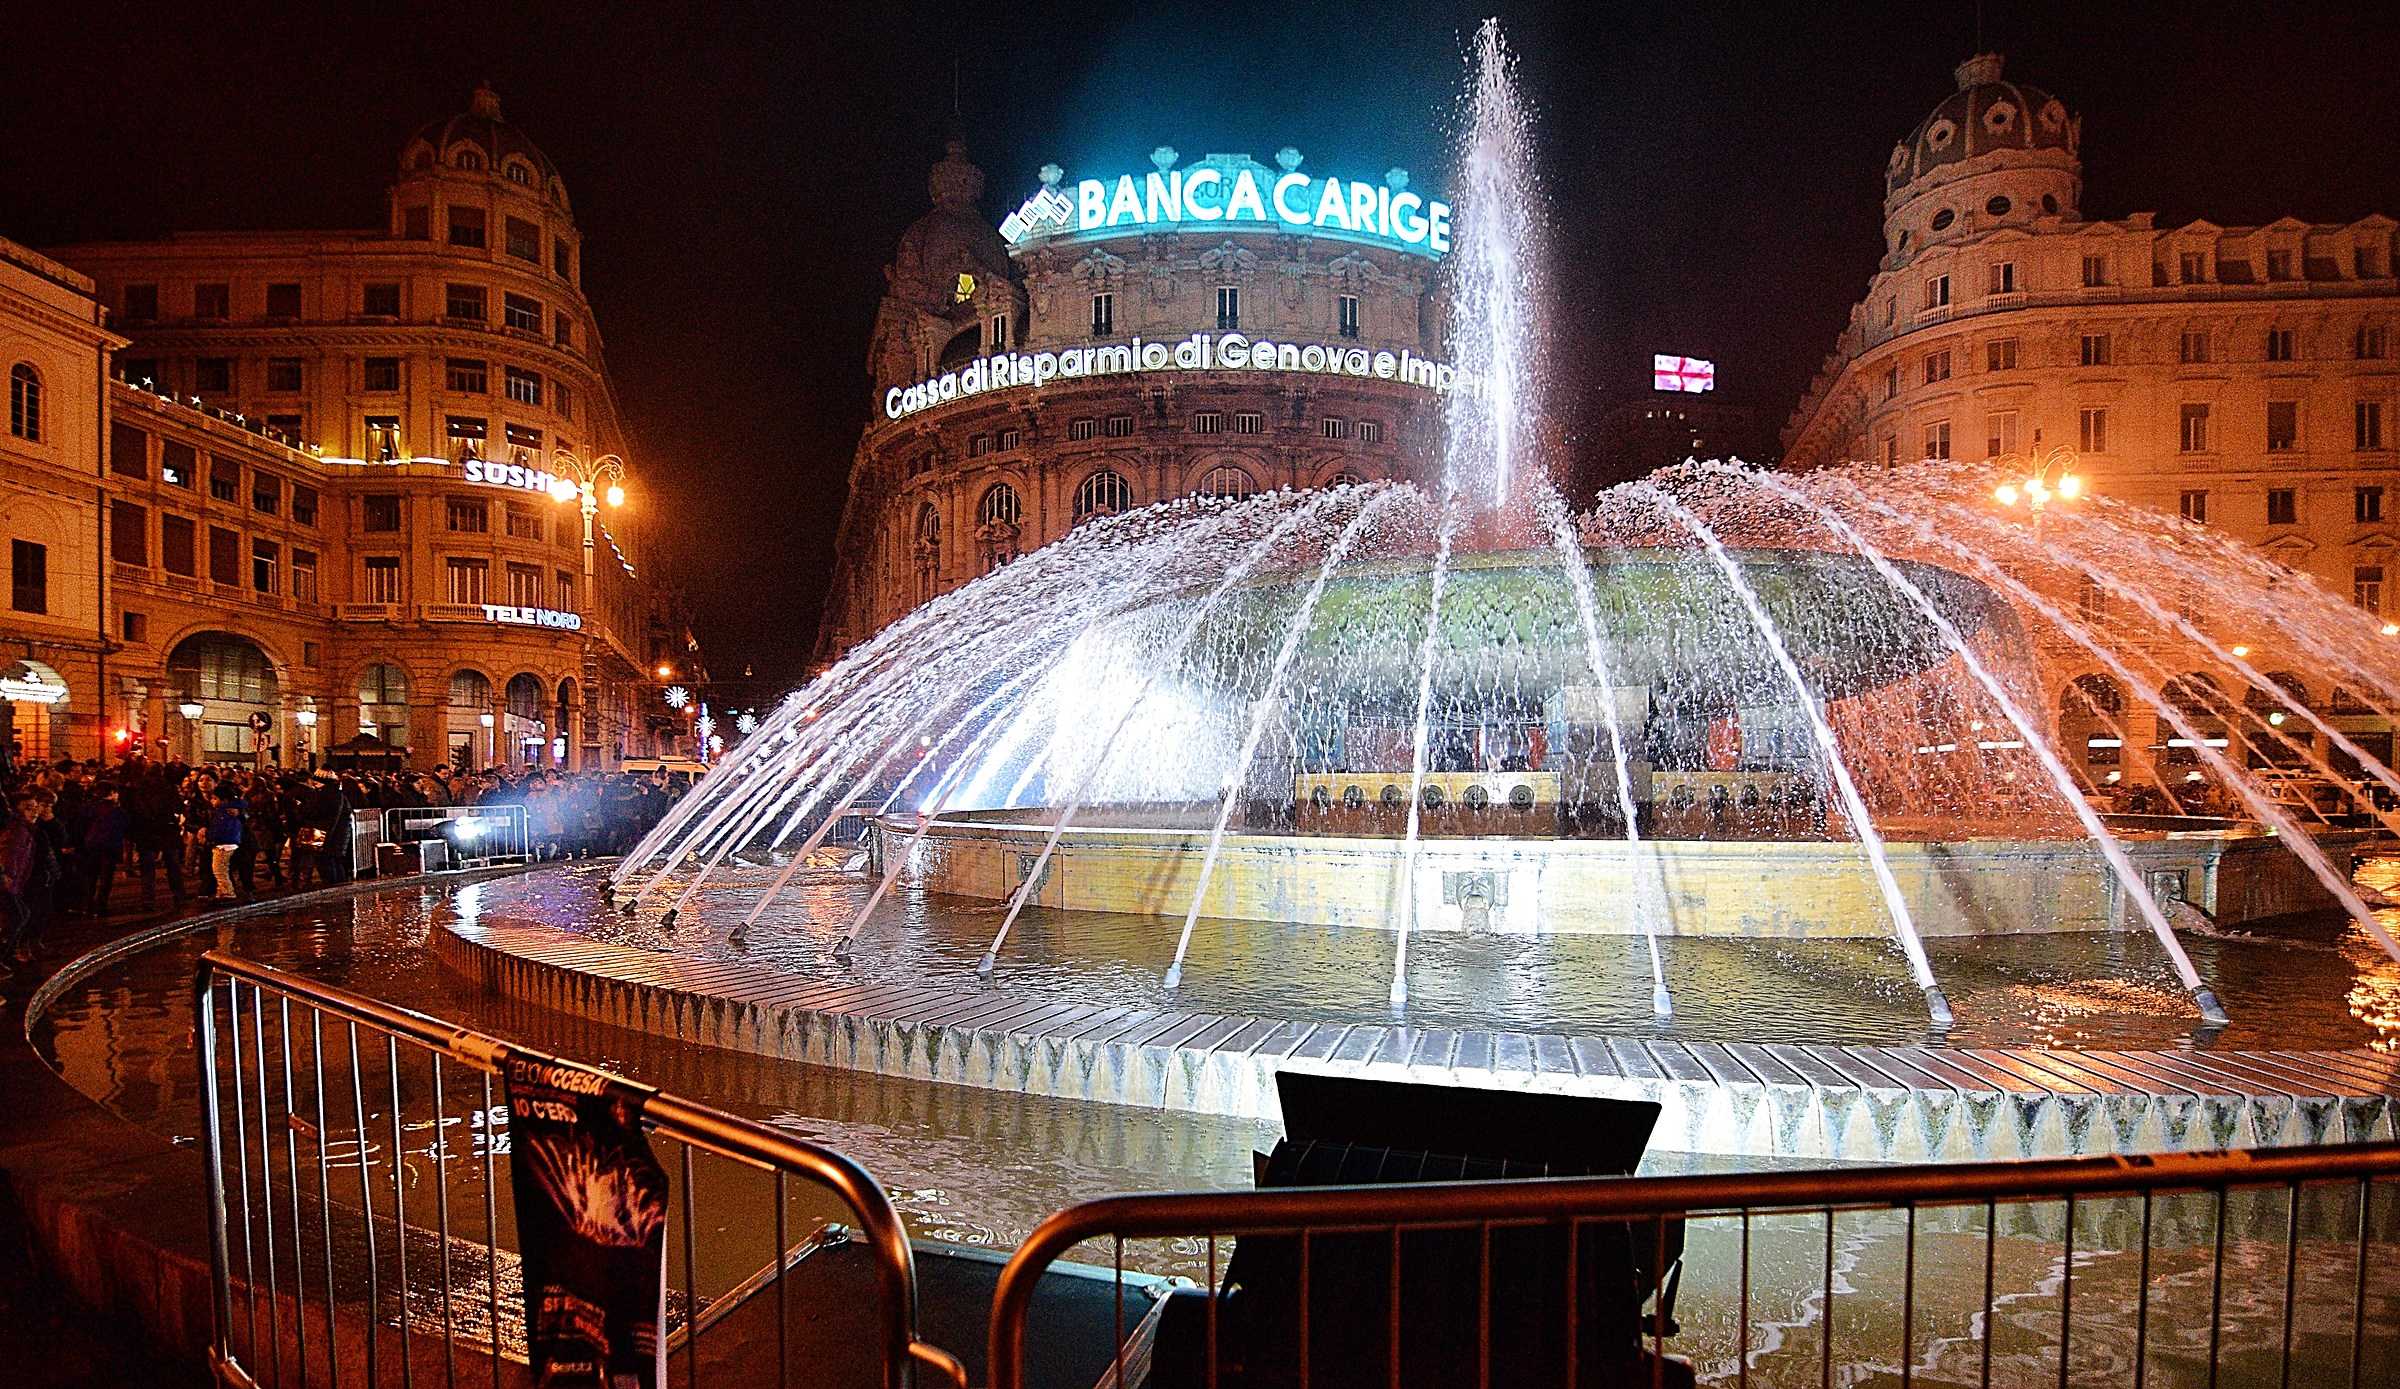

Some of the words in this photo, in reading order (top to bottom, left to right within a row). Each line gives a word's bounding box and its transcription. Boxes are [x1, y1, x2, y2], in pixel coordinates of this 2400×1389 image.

[1078, 168, 1267, 231] BANCA
[1273, 172, 1451, 253] CARIGE
[885, 371, 957, 419] Cassa
[960, 357, 989, 395] di
[990, 337, 1169, 387] Risparmio
[1173, 333, 1211, 370] di
[1217, 331, 1370, 377] Genova
[1373, 350, 1397, 379] e
